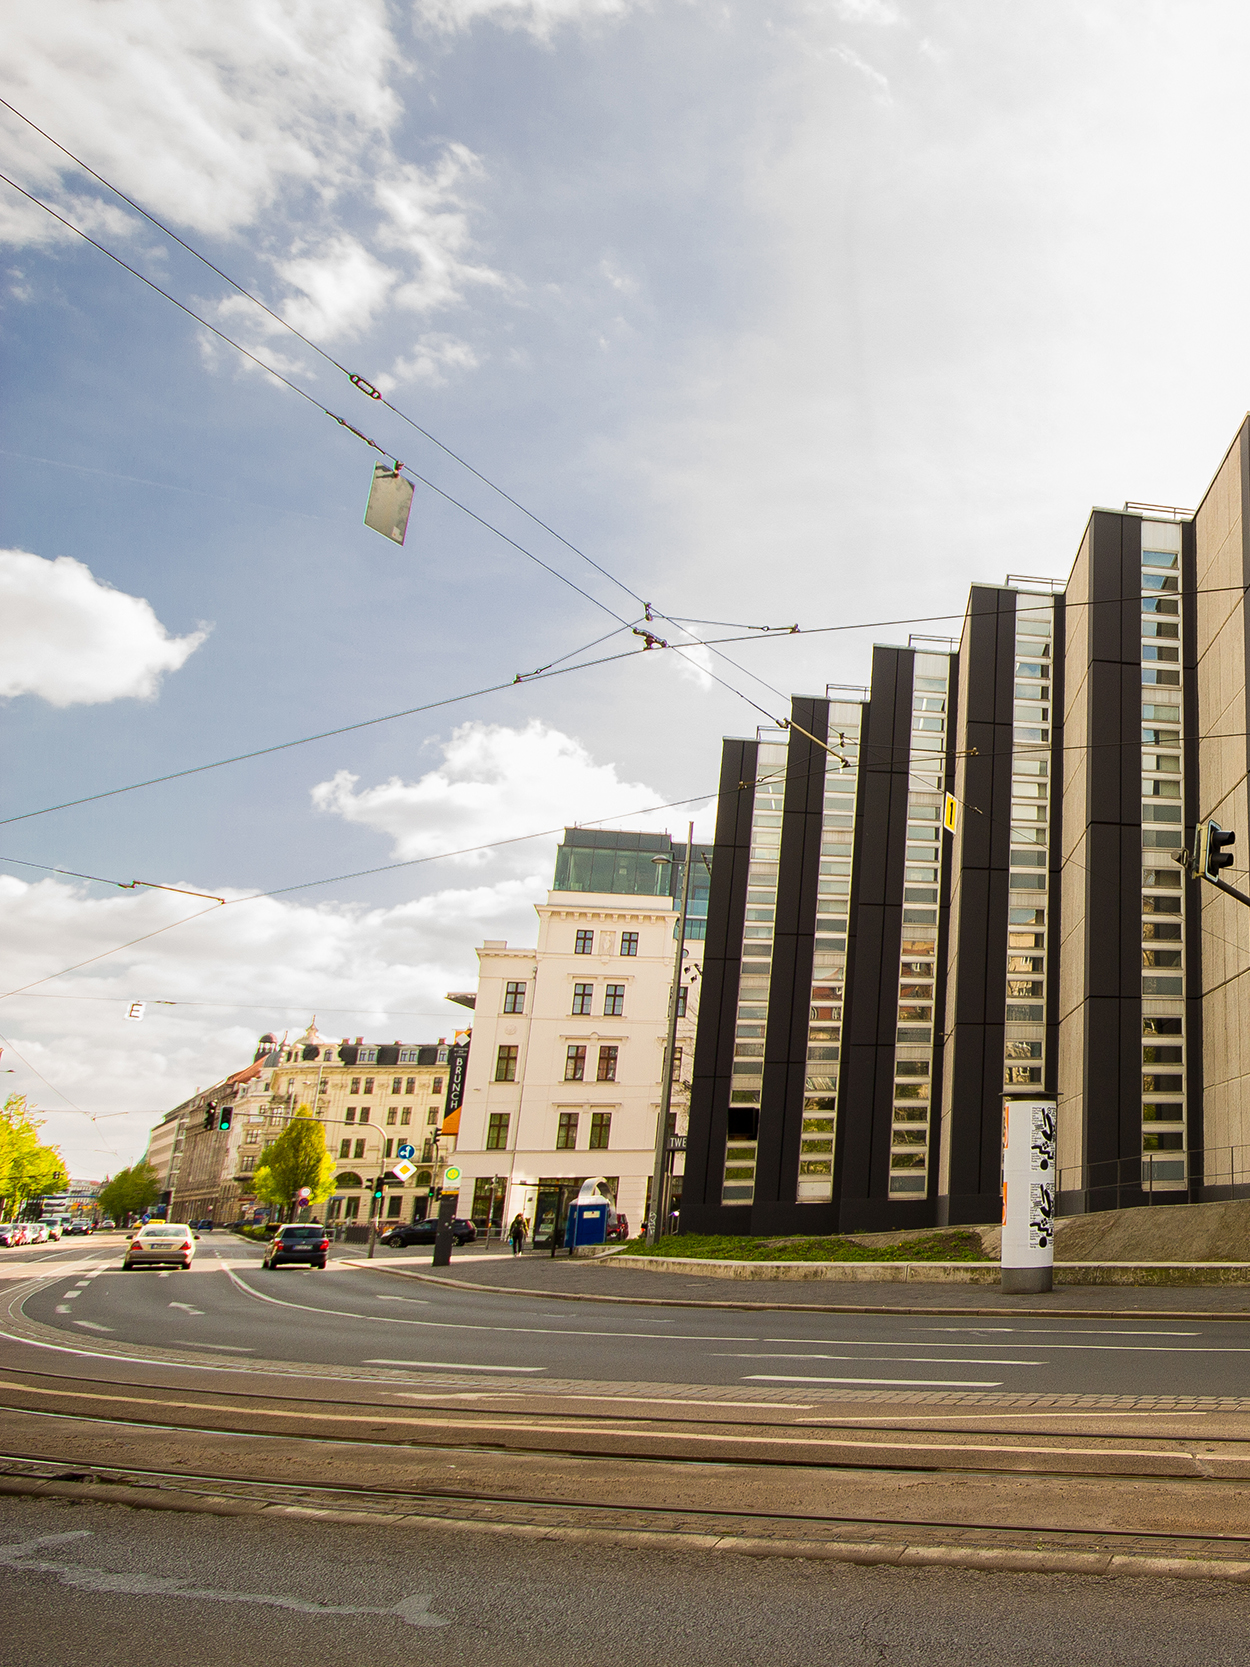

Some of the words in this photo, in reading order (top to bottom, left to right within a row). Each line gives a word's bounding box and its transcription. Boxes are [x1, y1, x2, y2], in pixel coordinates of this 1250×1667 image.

[129, 1003, 143, 1019] E
[450, 1057, 463, 1109] BRUNCH
[670, 1137, 687, 1148] TWE
